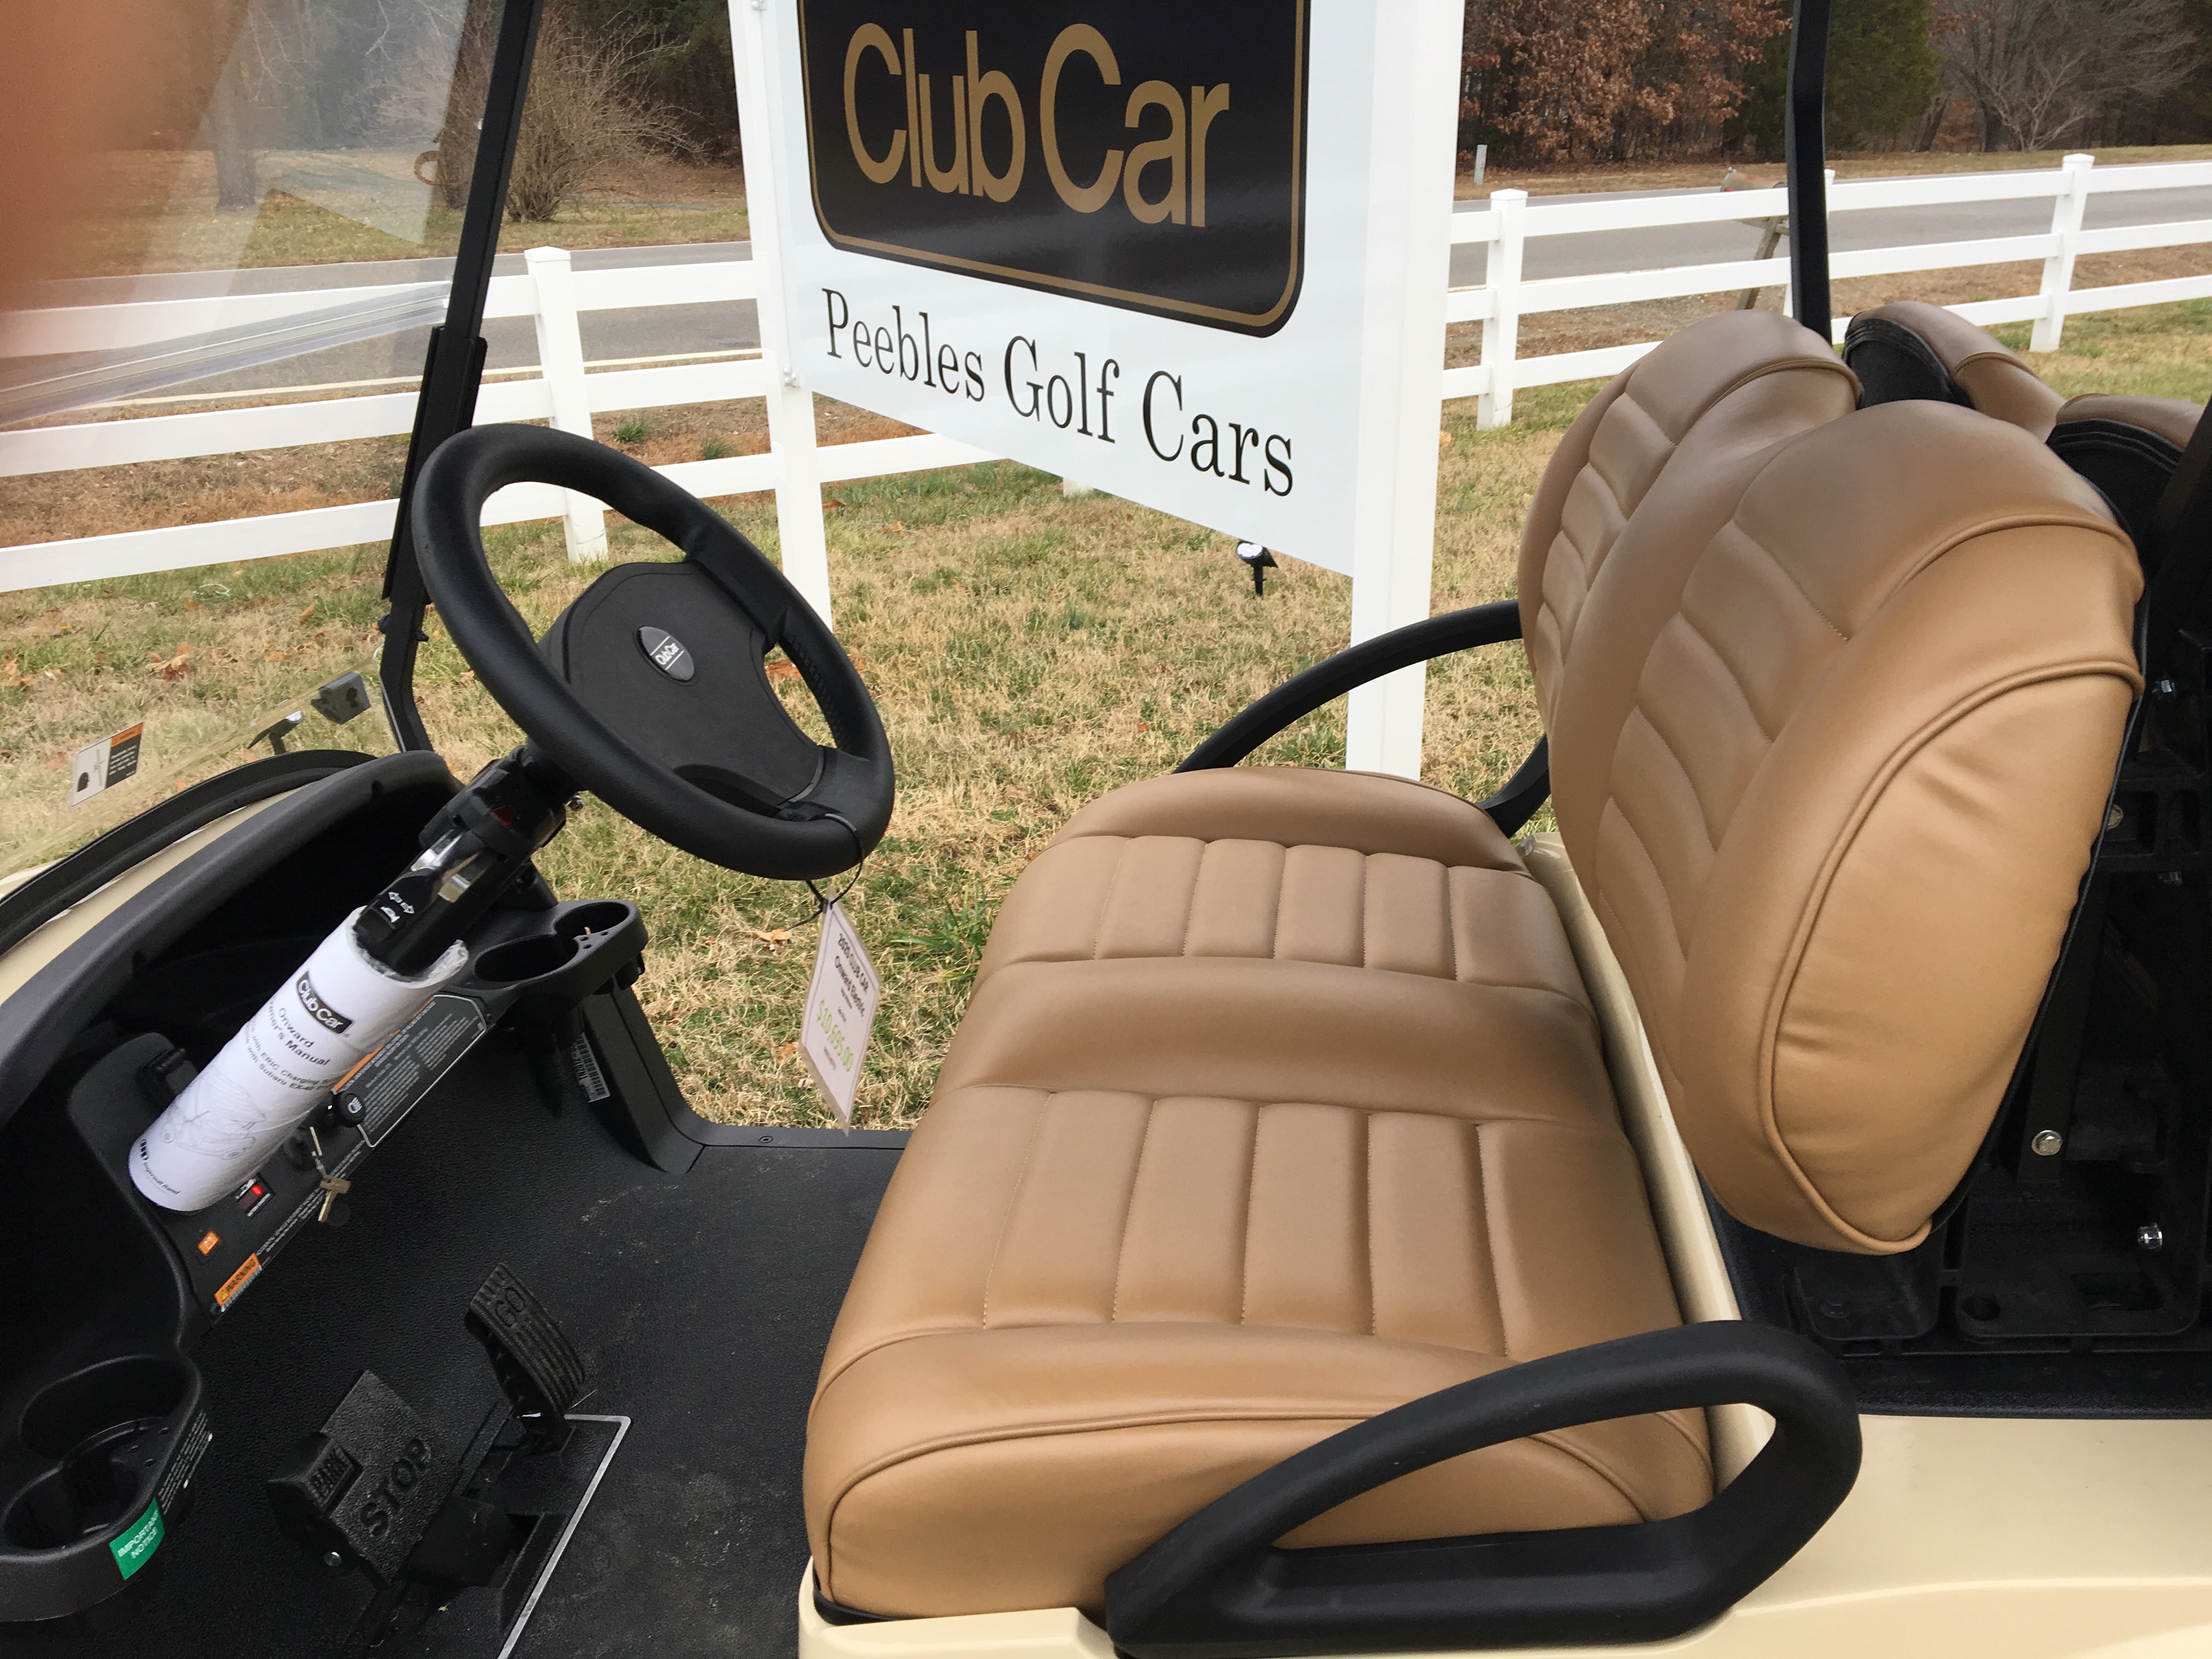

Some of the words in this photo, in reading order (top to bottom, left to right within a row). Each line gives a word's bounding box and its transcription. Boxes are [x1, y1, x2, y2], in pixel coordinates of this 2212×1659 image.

[844, 22, 1026, 203] Club
[1040, 23, 1230, 228] Car
[821, 287, 985, 403] Peebles
[1003, 335, 1120, 444] Golf
[1142, 370, 1293, 497] Cars
[298, 979, 319, 1012] Club
[316, 1008, 343, 1029] Car
[278, 1007, 315, 1048] Onward
[258, 1063, 287, 1086] Subaru
[285, 1040, 331, 1066] Manual
[280, 1070, 319, 1085] Charging
[494, 1285, 527, 1328] GO
[360, 1438, 426, 1536] STOP
